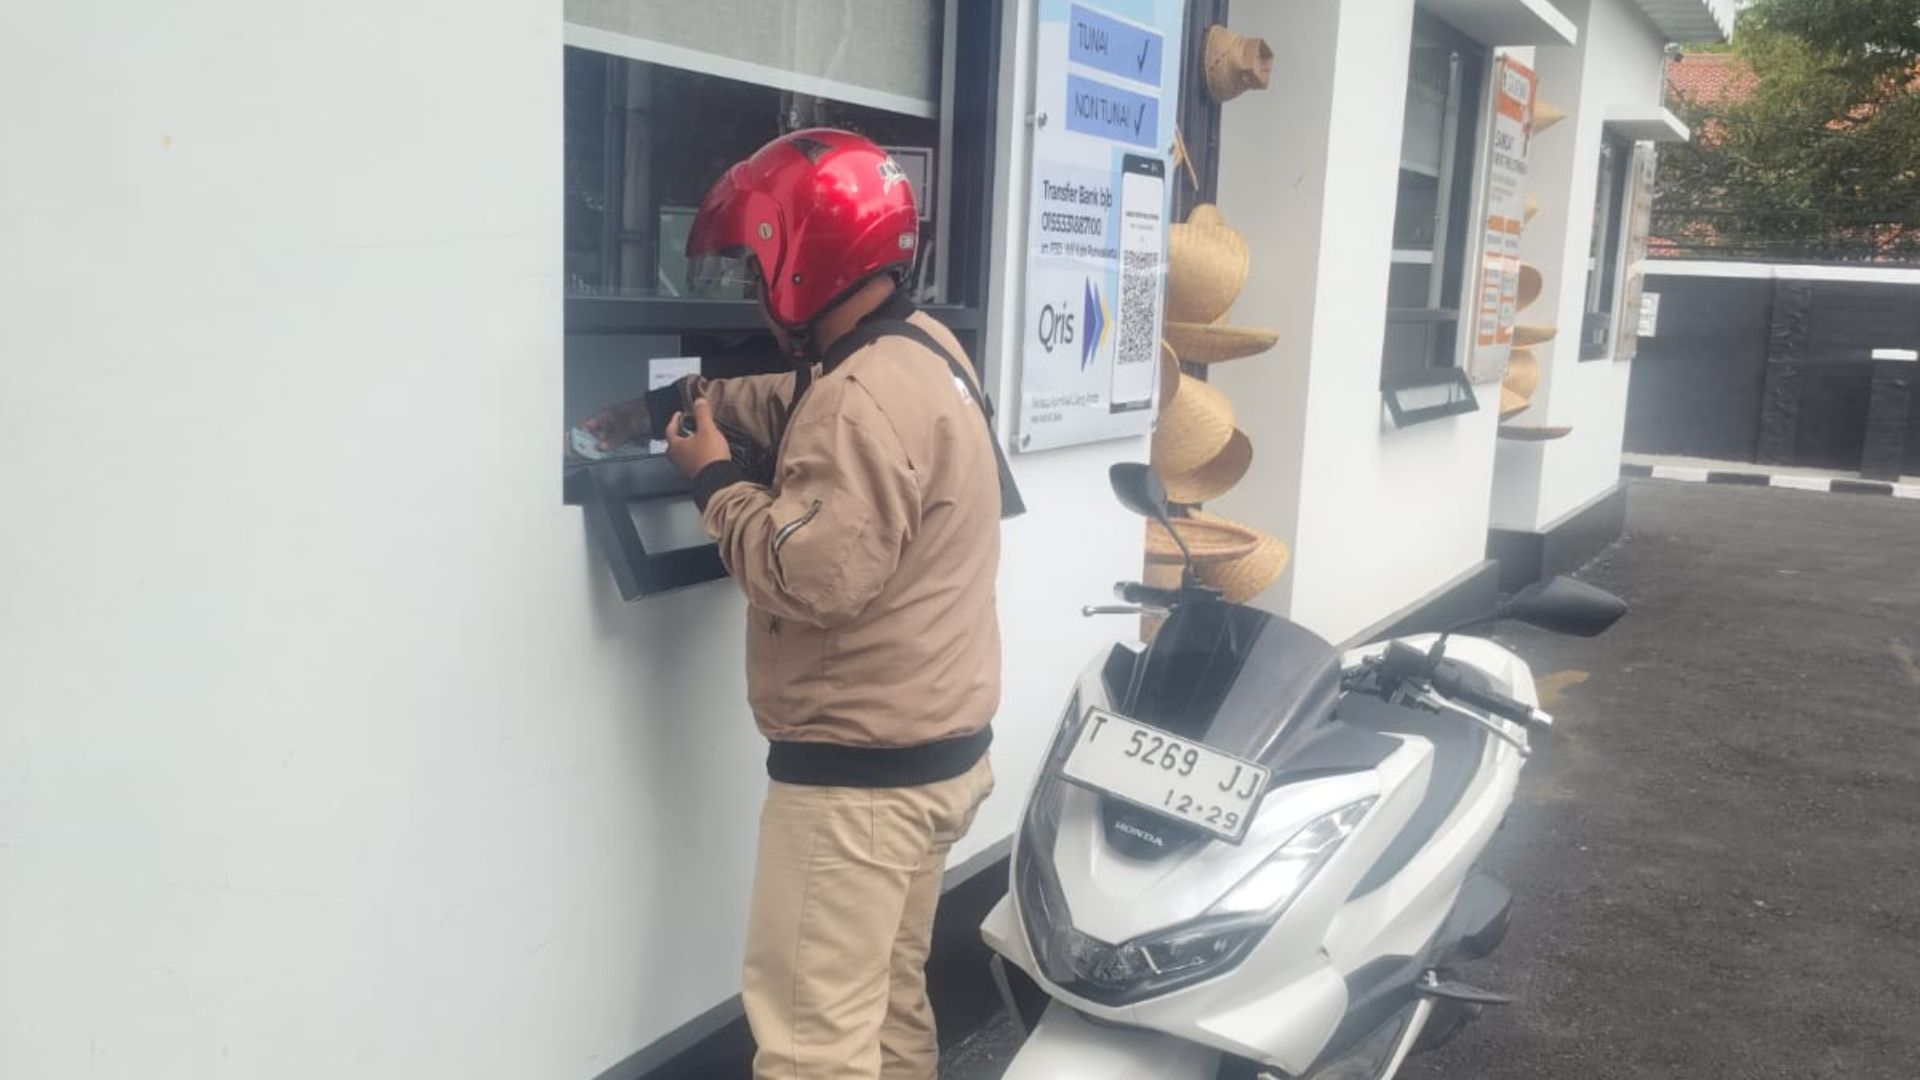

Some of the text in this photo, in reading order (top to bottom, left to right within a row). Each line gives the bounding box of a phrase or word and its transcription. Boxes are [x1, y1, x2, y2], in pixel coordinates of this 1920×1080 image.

[1077, 22, 1109, 56] TUNAI
[1075, 92, 1130, 129] NON TUNAI
[1043, 180, 1078, 203] Transfer
[1079, 185, 1098, 206] Bank
[1038, 301, 1075, 353] Qris
[1089, 716, 1260, 800] T 5269 JJ
[1113, 820, 1164, 847] HONDA
